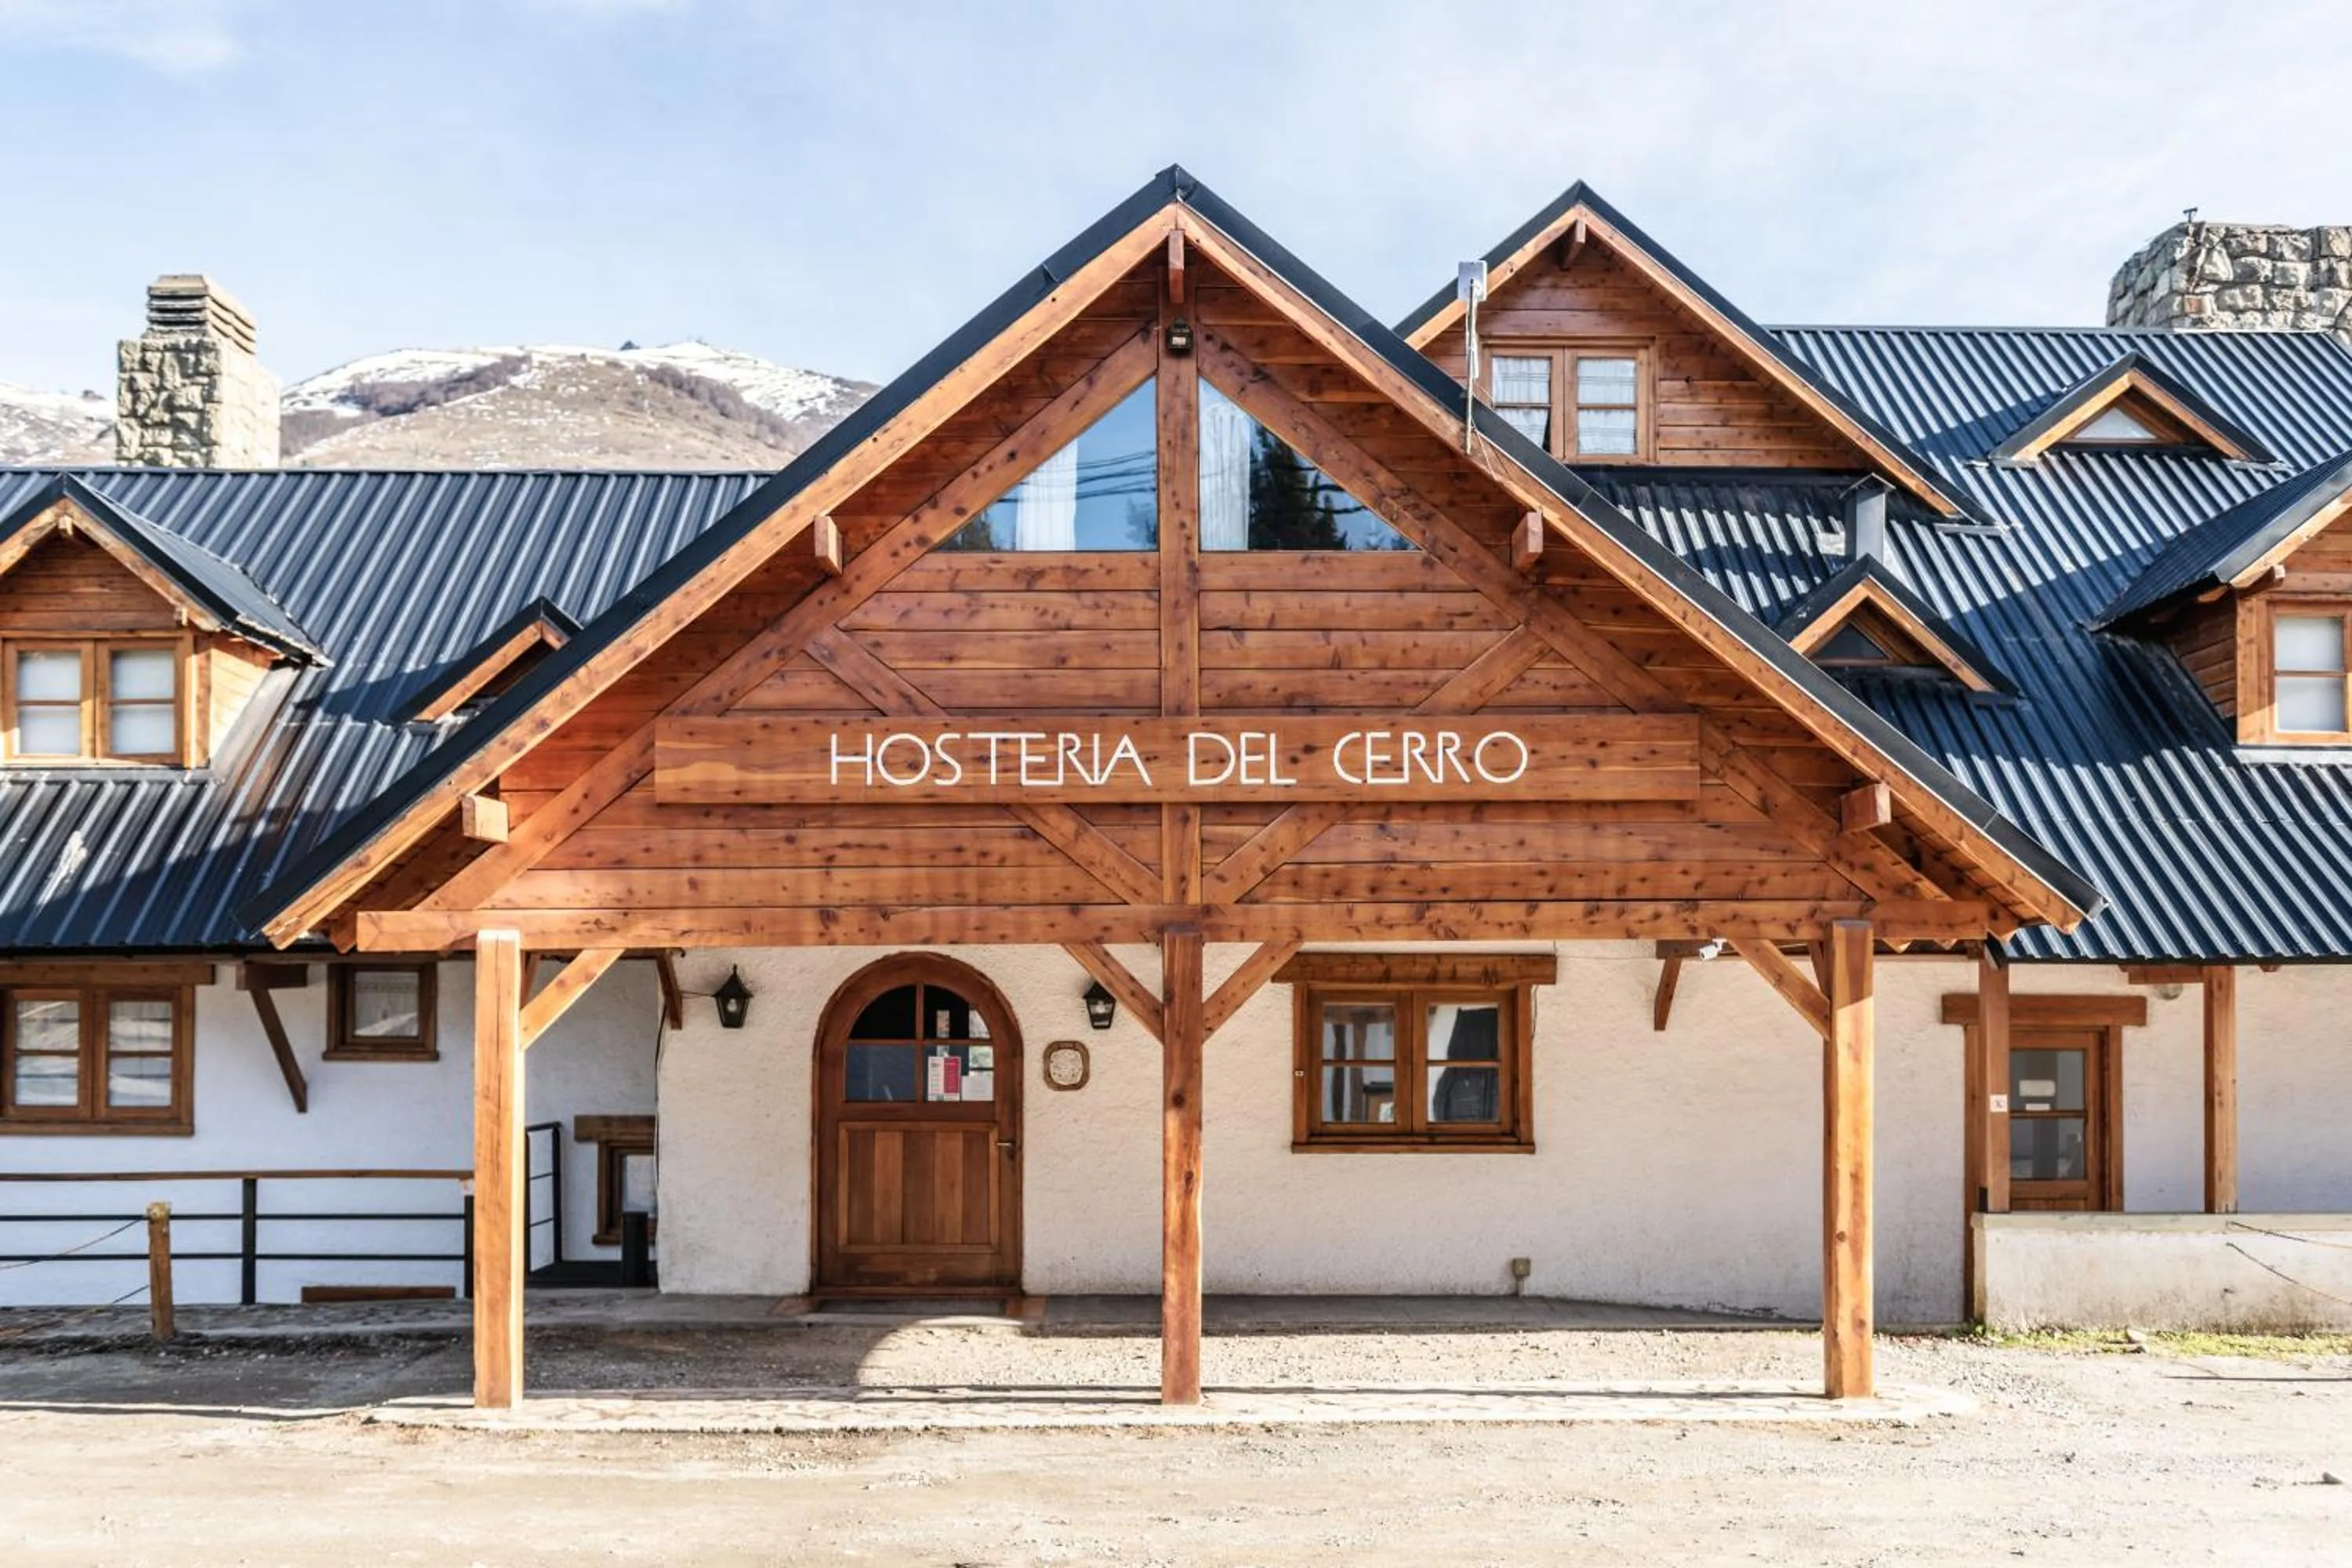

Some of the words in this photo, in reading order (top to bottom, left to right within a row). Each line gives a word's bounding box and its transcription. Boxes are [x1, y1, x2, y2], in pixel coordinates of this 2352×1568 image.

[829, 732, 1152, 786] HOSTERIA
[1188, 732, 1298, 786] DEL
[1333, 731, 1529, 785] CERRO
